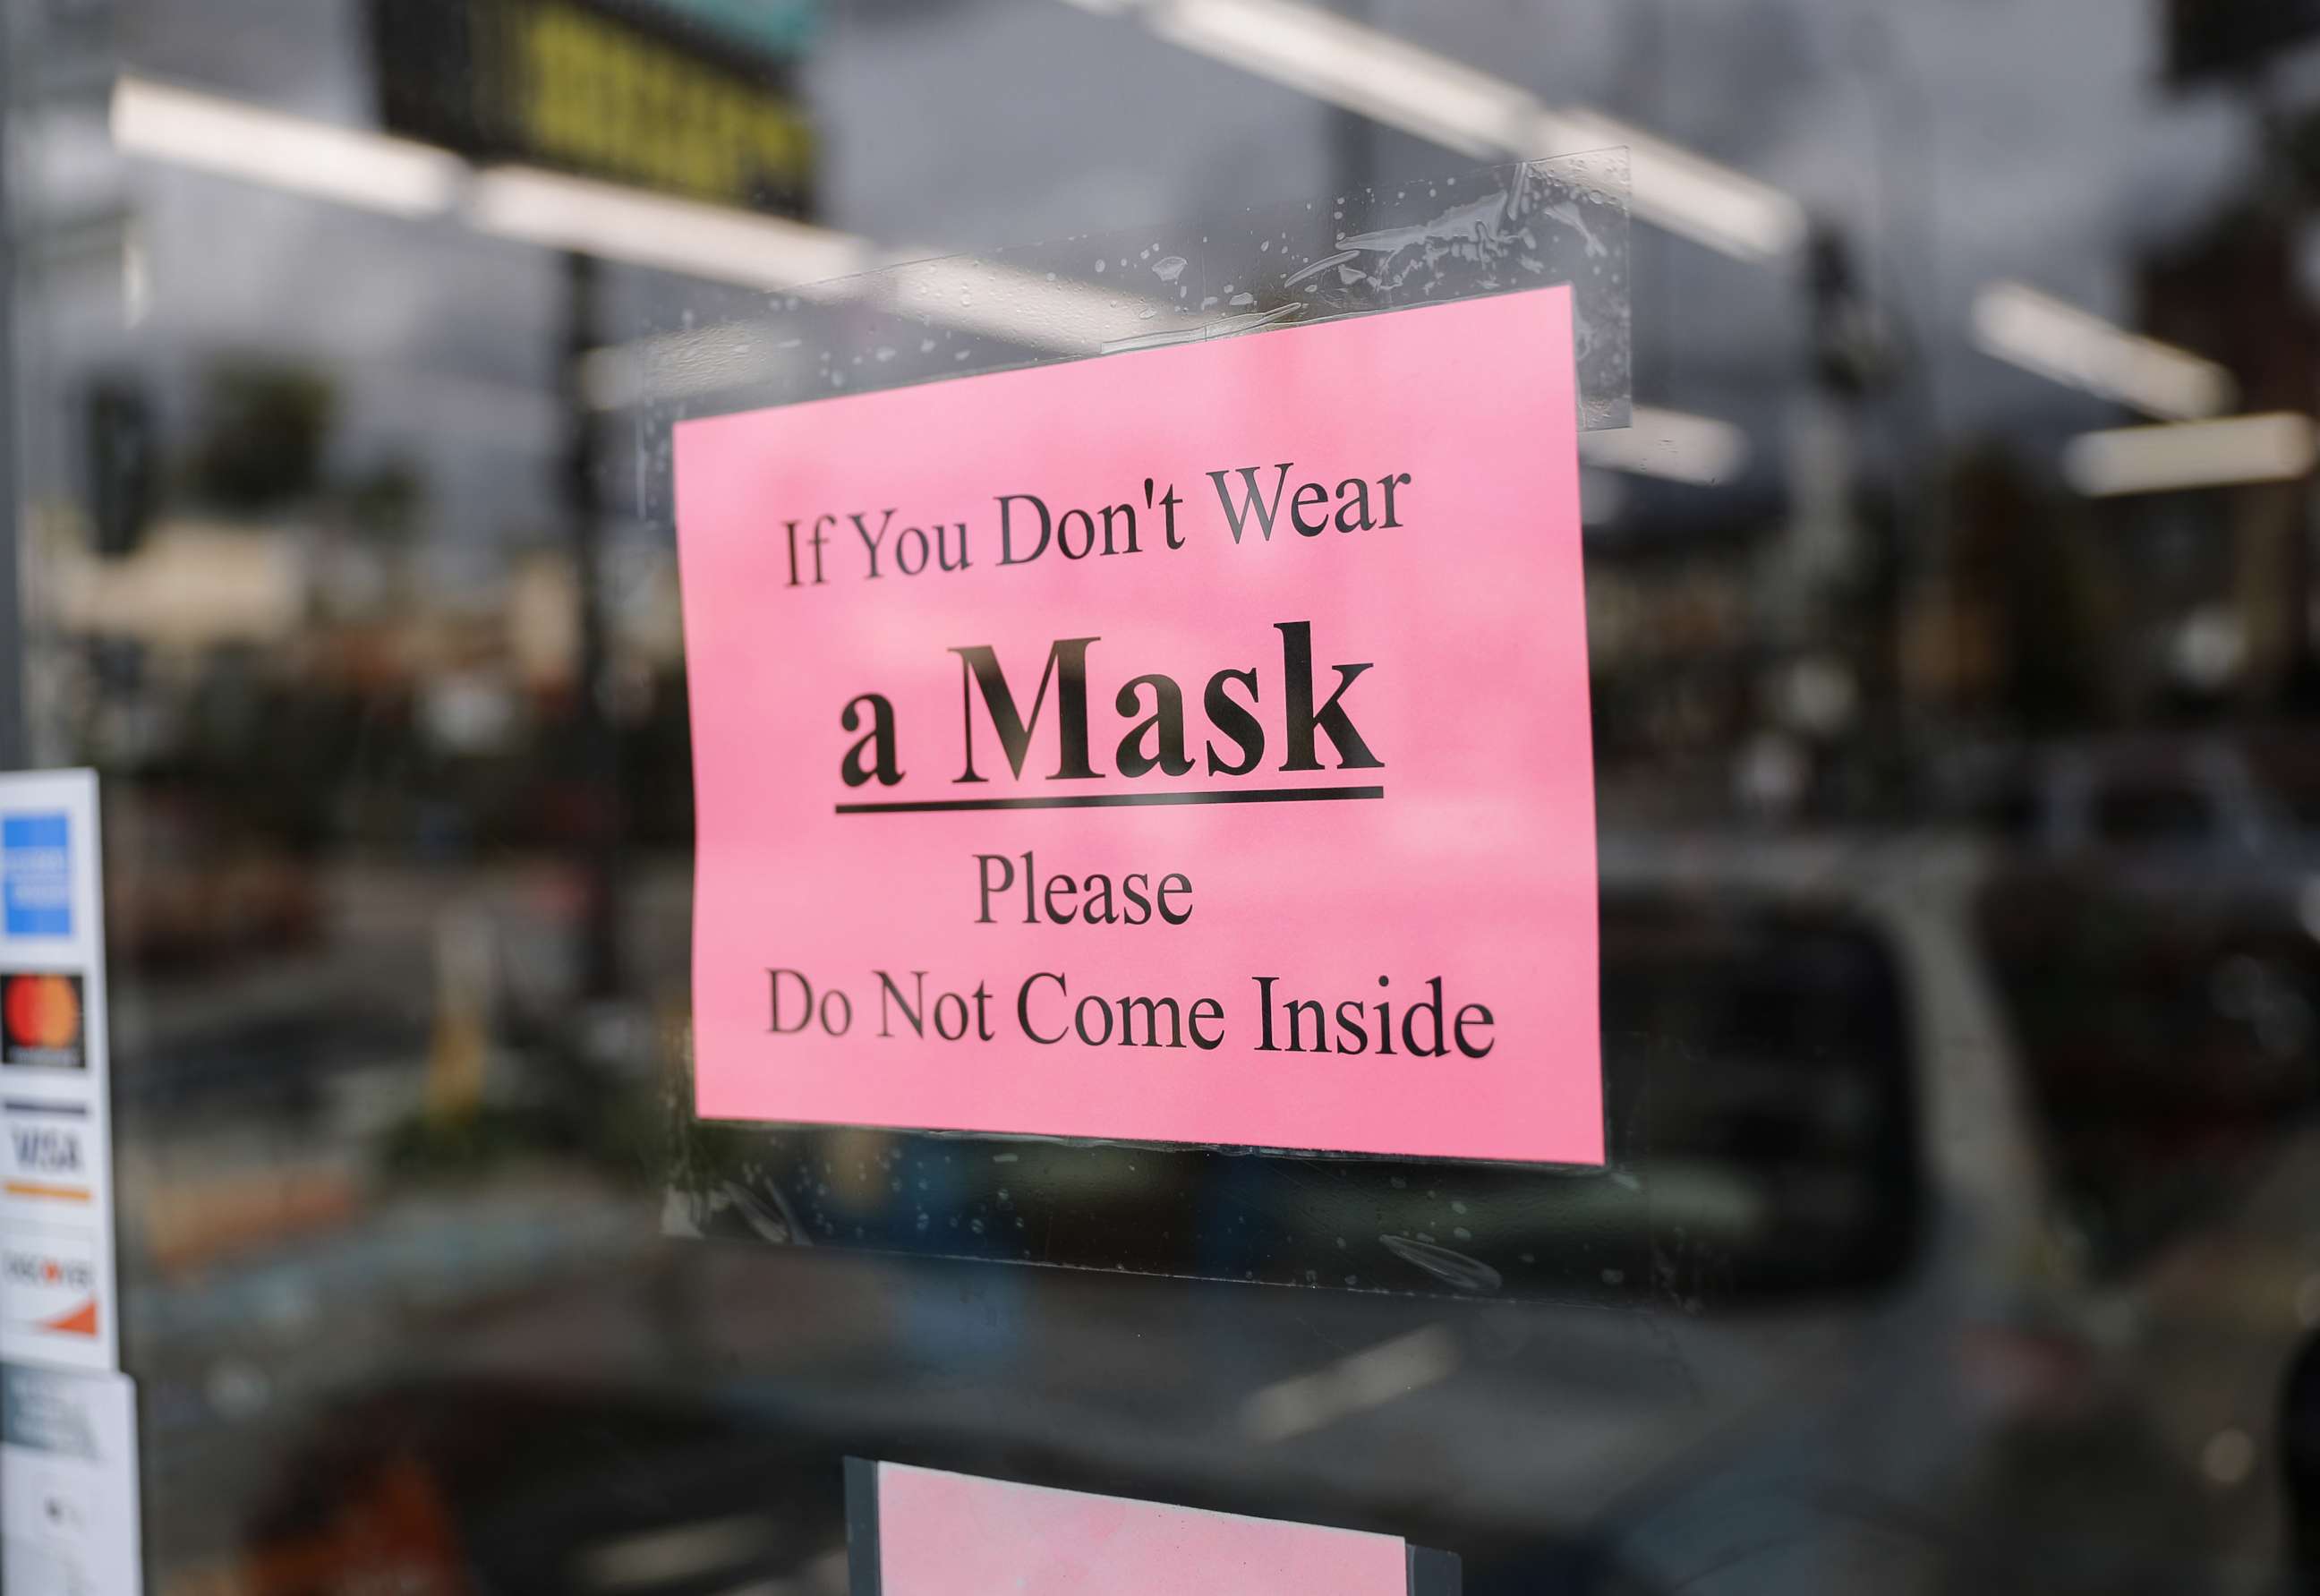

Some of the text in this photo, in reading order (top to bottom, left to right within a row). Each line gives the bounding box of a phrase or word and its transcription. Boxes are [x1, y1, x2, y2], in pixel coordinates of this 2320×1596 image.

[784, 462, 1412, 587] If You Don't Wear
[840, 620, 1386, 788] a Mask
[974, 851, 1193, 926] Please
[767, 969, 1496, 1059] Do Not Come Inside
